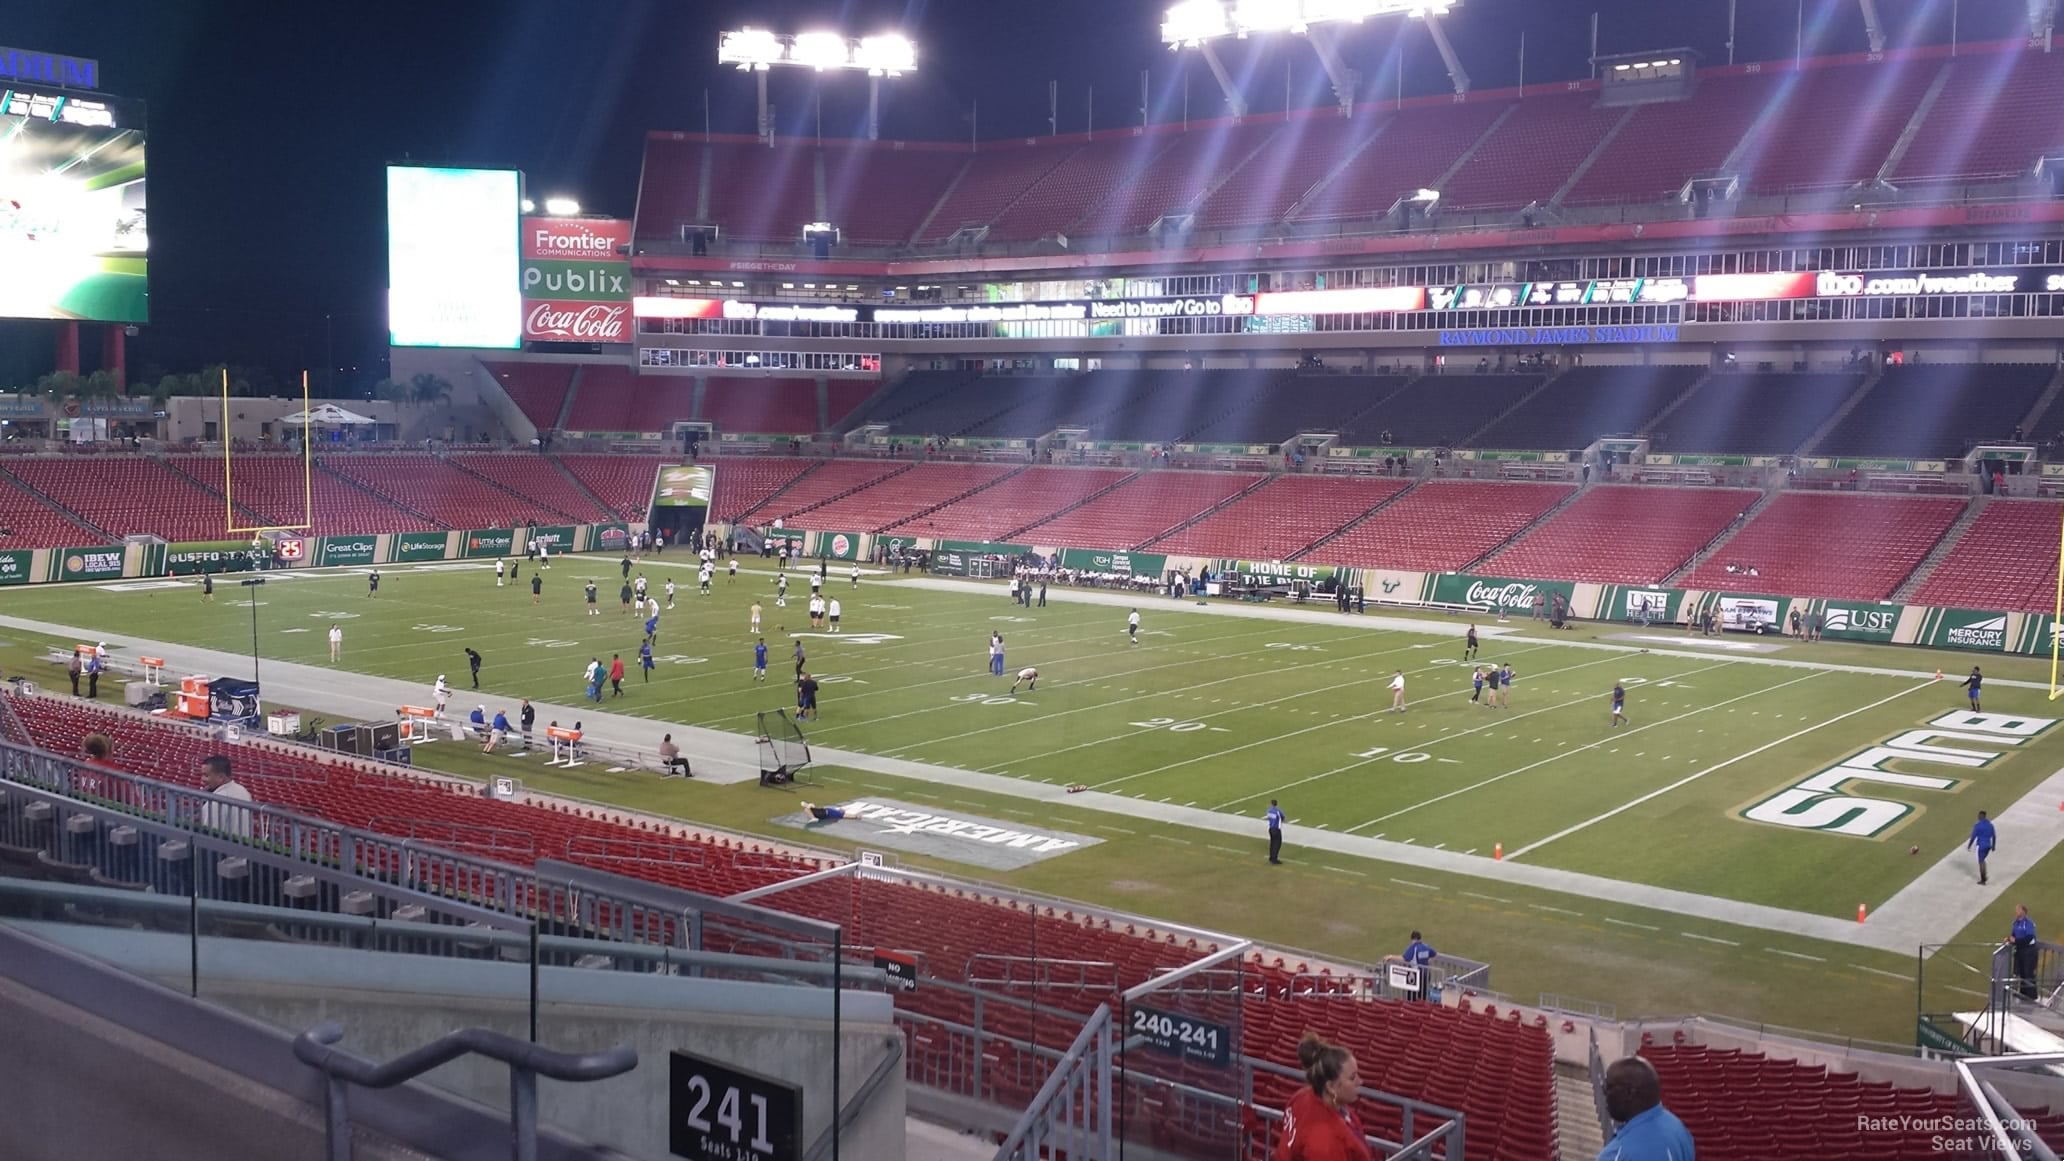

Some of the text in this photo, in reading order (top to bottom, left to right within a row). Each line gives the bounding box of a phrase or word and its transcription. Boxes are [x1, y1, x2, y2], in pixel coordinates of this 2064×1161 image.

[1745, 64, 1760, 73] 310
[536, 230, 616, 250] Frontier
[536, 249, 611, 257] COMMUNICATIONS
[524, 267, 624, 293] Publix
[1092, 302, 1125, 317] Need
[1126, 303, 1140, 317] to
[1140, 300, 1183, 316] know?
[1184, 299, 1204, 315] Go
[1206, 300, 1220, 315] to
[526, 303, 629, 337] Coca-Cola
[1439, 325, 1678, 346] RAYMOND JAMES STADIUM
[536, 533, 560, 543] schutt
[281, 541, 300, 556] 25
[326, 542, 373, 553] Great Clips
[84, 553, 120, 562] IBEW
[1094, 556, 1111, 566] TGH
[1250, 562, 1318, 579] HOME OF
[1466, 580, 1537, 609] Coca-Cola
[1630, 592, 1668, 609] USF
[1850, 610, 1895, 629] USF
[1948, 628, 2003, 639] MERCURY
[1948, 636, 2001, 646] INSURANCE
[1128, 717, 1206, 732] 20
[1348, 747, 1431, 763] 10
[1740, 709, 2062, 838] BULLS
[888, 962, 901, 973] NO
[1134, 1010, 1217, 1050] 240-241
[687, 1074, 774, 1155] 241
[701, 1135, 731, 1159] Seats
